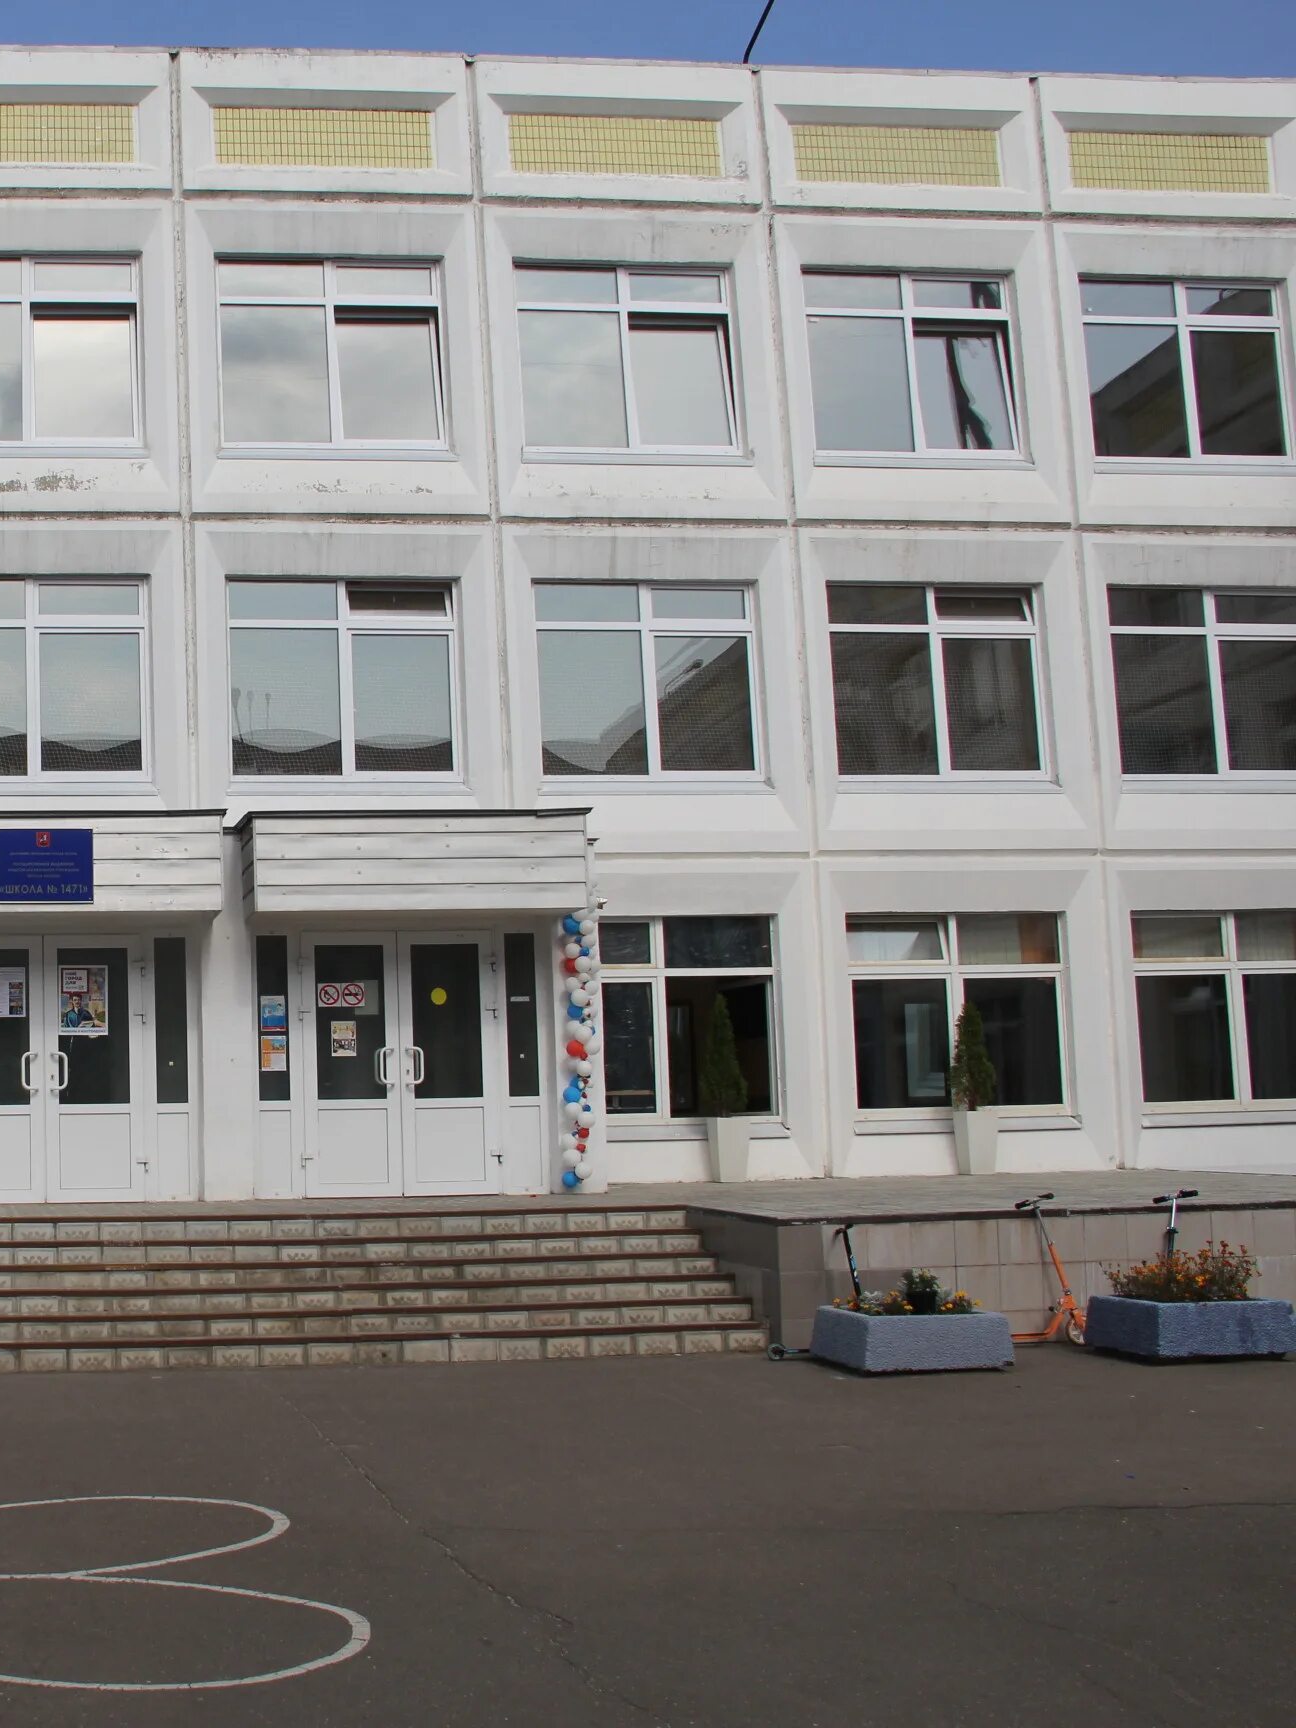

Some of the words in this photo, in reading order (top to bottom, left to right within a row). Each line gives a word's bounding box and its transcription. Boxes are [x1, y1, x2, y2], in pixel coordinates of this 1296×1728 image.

[0, 884, 43, 894] «ШКОЛА
[47, 884, 58, 894] №
[61, 884, 88, 894] 1471»
